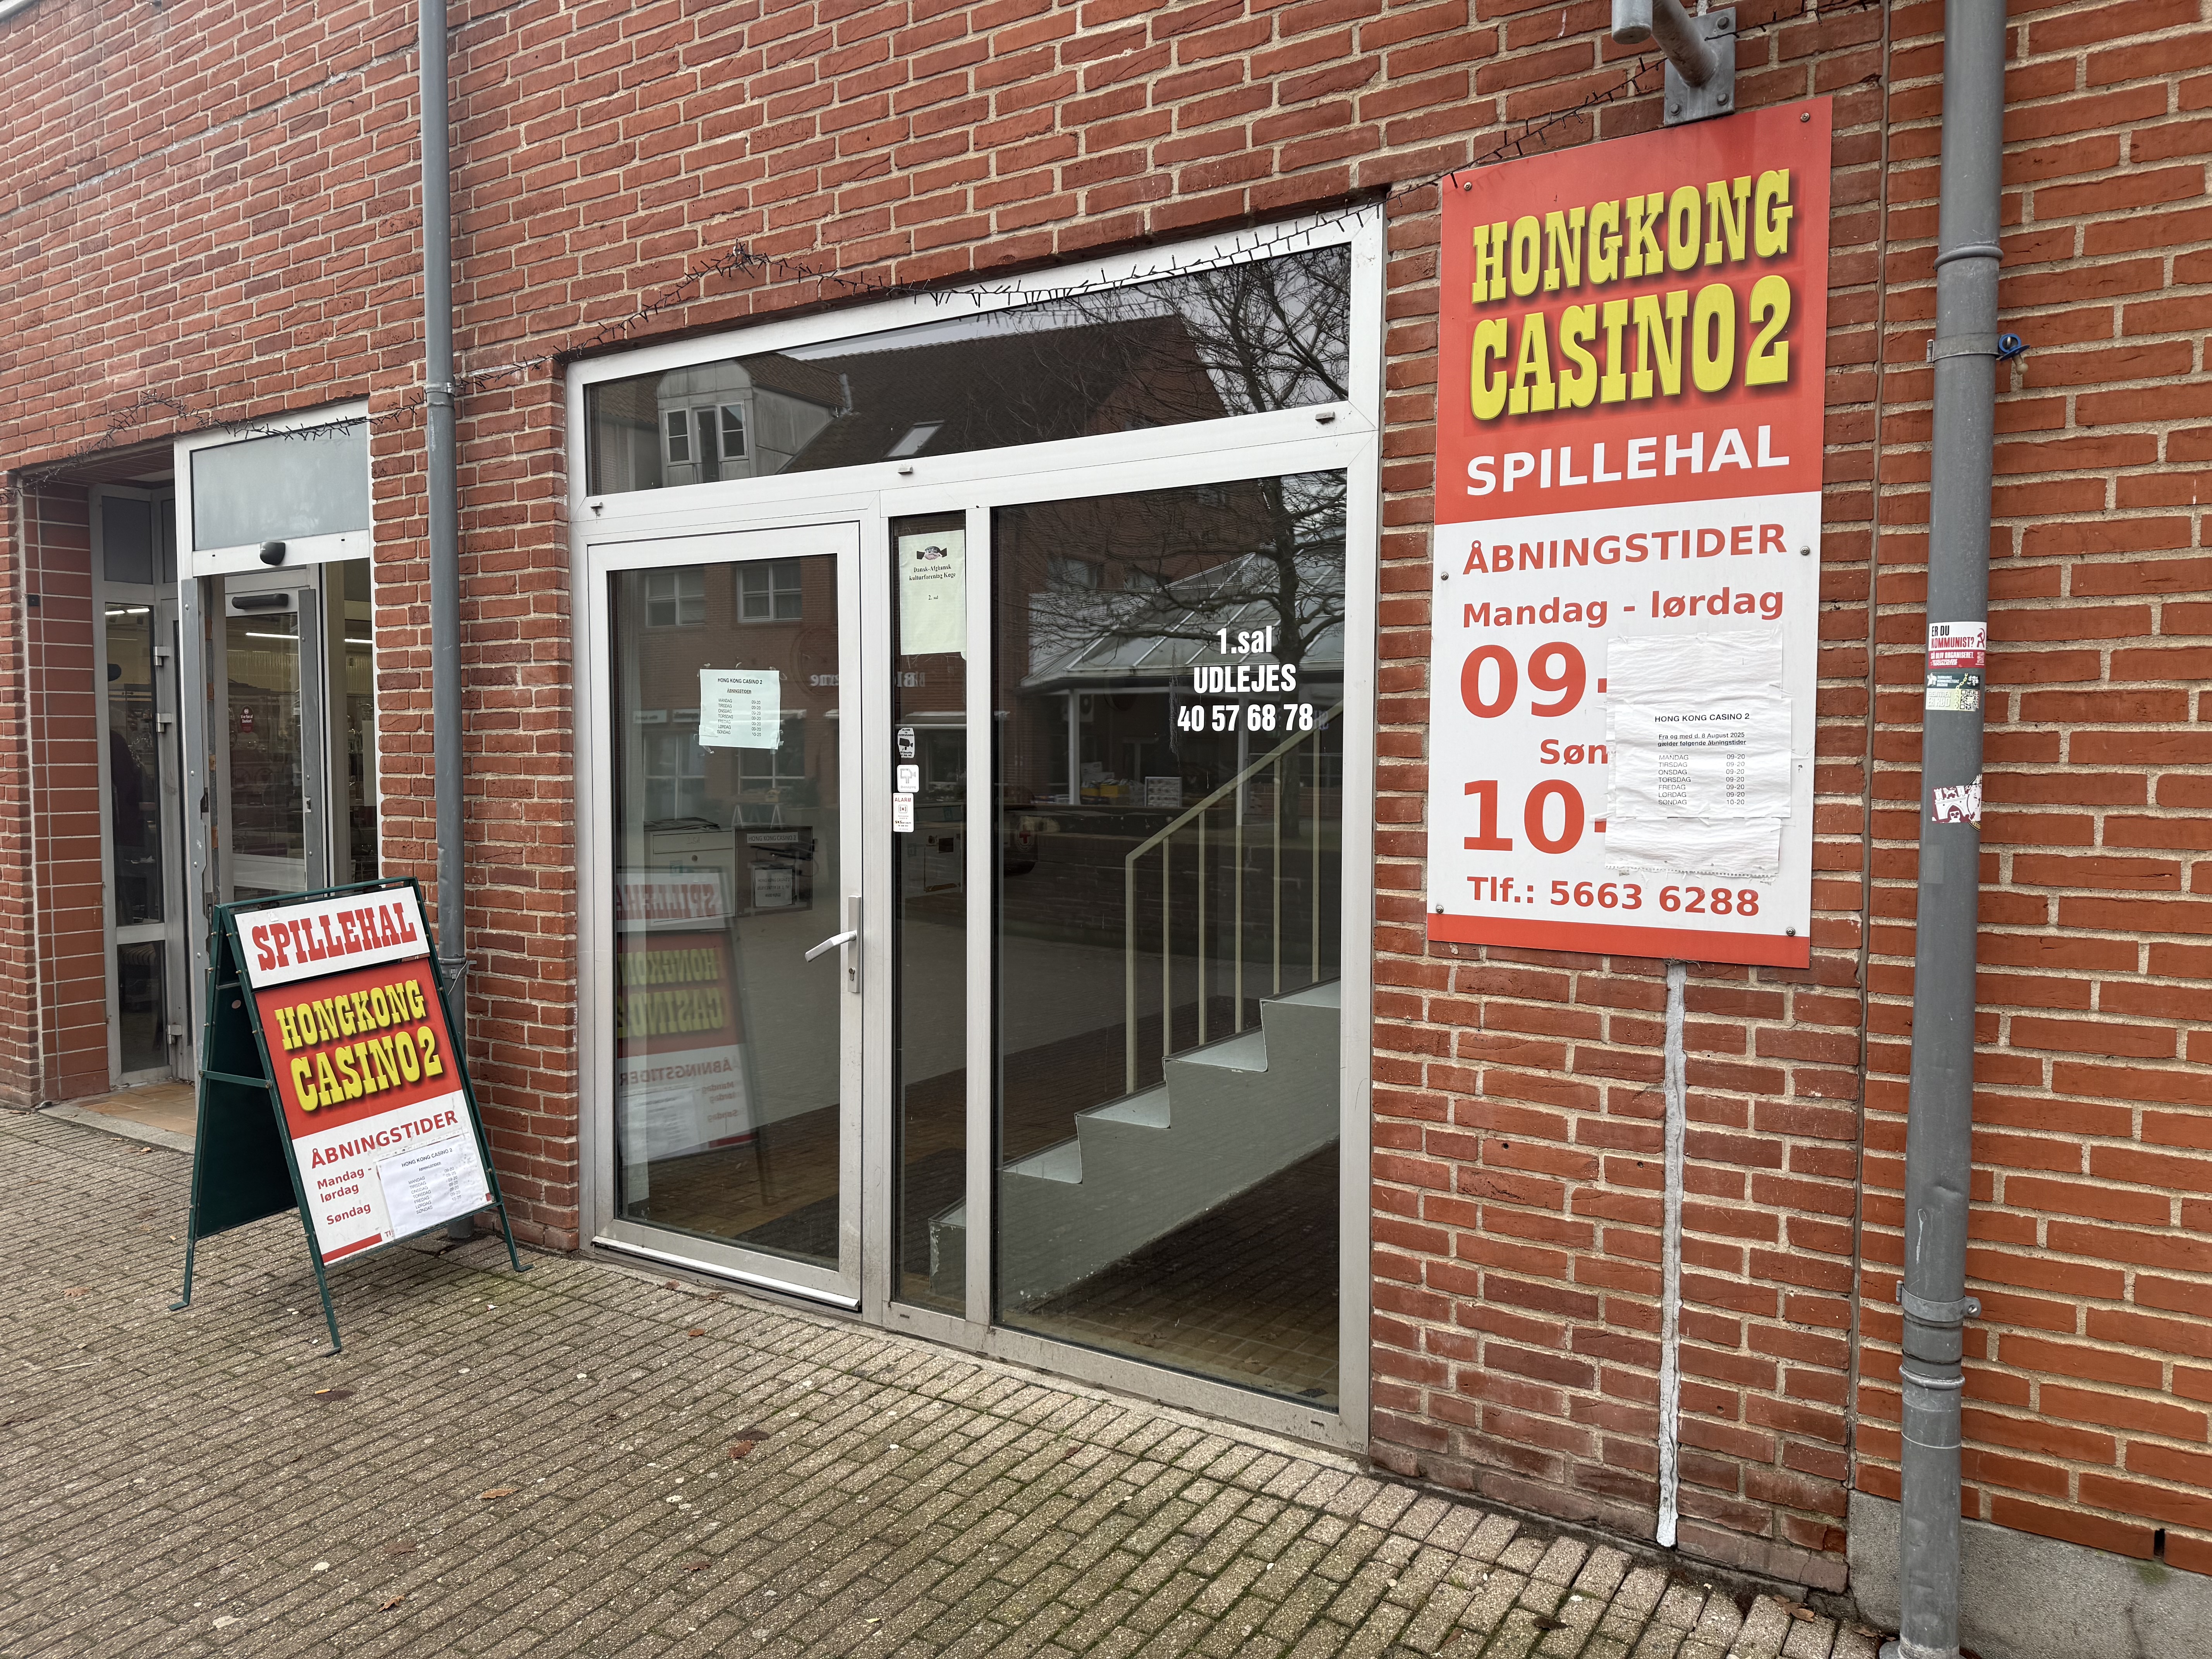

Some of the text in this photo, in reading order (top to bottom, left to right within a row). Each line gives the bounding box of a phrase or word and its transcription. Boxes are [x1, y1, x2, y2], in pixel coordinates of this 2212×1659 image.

[1472, 169, 1793, 304] HONGKONG
[1471, 275, 1791, 420] CASINO 2
[1467, 425, 1789, 496] SPILLEHAL
[1463, 523, 1787, 575] ÅBNINGSTIDER
[1463, 597, 1608, 628] Mandag
[1652, 587, 1783, 619] lørdag
[1931, 637, 1974, 649] KOMMUNIST?
[1932, 625, 1949, 637] ER DU
[1194, 664, 1296, 693] UDLEJES
[1177, 705, 1204, 732] 40
[1212, 705, 1240, 731] 57
[1247, 704, 1276, 731] 68
[1283, 703, 1313, 731] 78
[1540, 738, 1608, 765] Søn
[1468, 876, 1760, 916] Tlf.: 5663 6288
[251, 902, 418, 972] SPILLEHAL
[275, 979, 426, 1051] HONGKONG
[290, 1026, 443, 1112] CASINO 2
[311, 1110, 458, 1169] ÅBNINGSTIDER
[431, 1149, 448, 1158] CASINO
[317, 1168, 364, 1189] Mandag
[320, 1183, 359, 1202] lørdag
[408, 1176, 425, 1185] MANDAG
[409, 1181, 426, 1189] TIRSDAG
[413, 1190, 431, 1199] TORSDAG
[414, 1196, 429, 1204] FREDAG
[326, 1204, 371, 1224] Søndag
